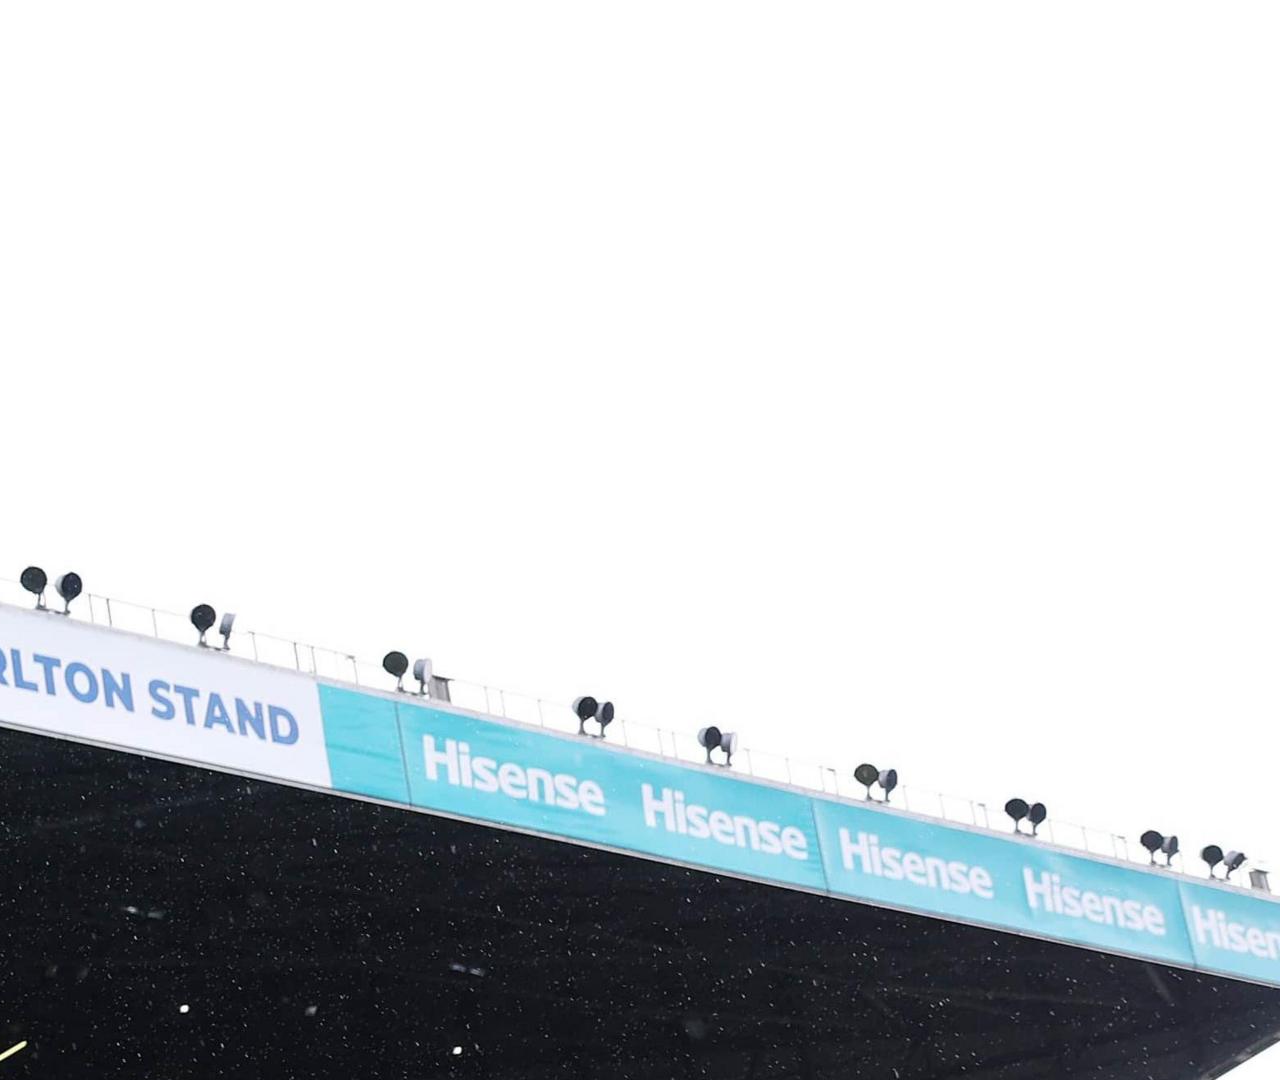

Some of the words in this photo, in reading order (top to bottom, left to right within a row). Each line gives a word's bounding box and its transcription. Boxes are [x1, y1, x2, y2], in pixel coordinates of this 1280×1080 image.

[147, 679, 300, 747] STAND
[422, 734, 606, 816] Hisense
[641, 783, 809, 860] Hisense
[838, 827, 994, 899] Hisense
[1023, 866, 1167, 935] Hisense
[1191, 904, 1280, 960] Hisen
